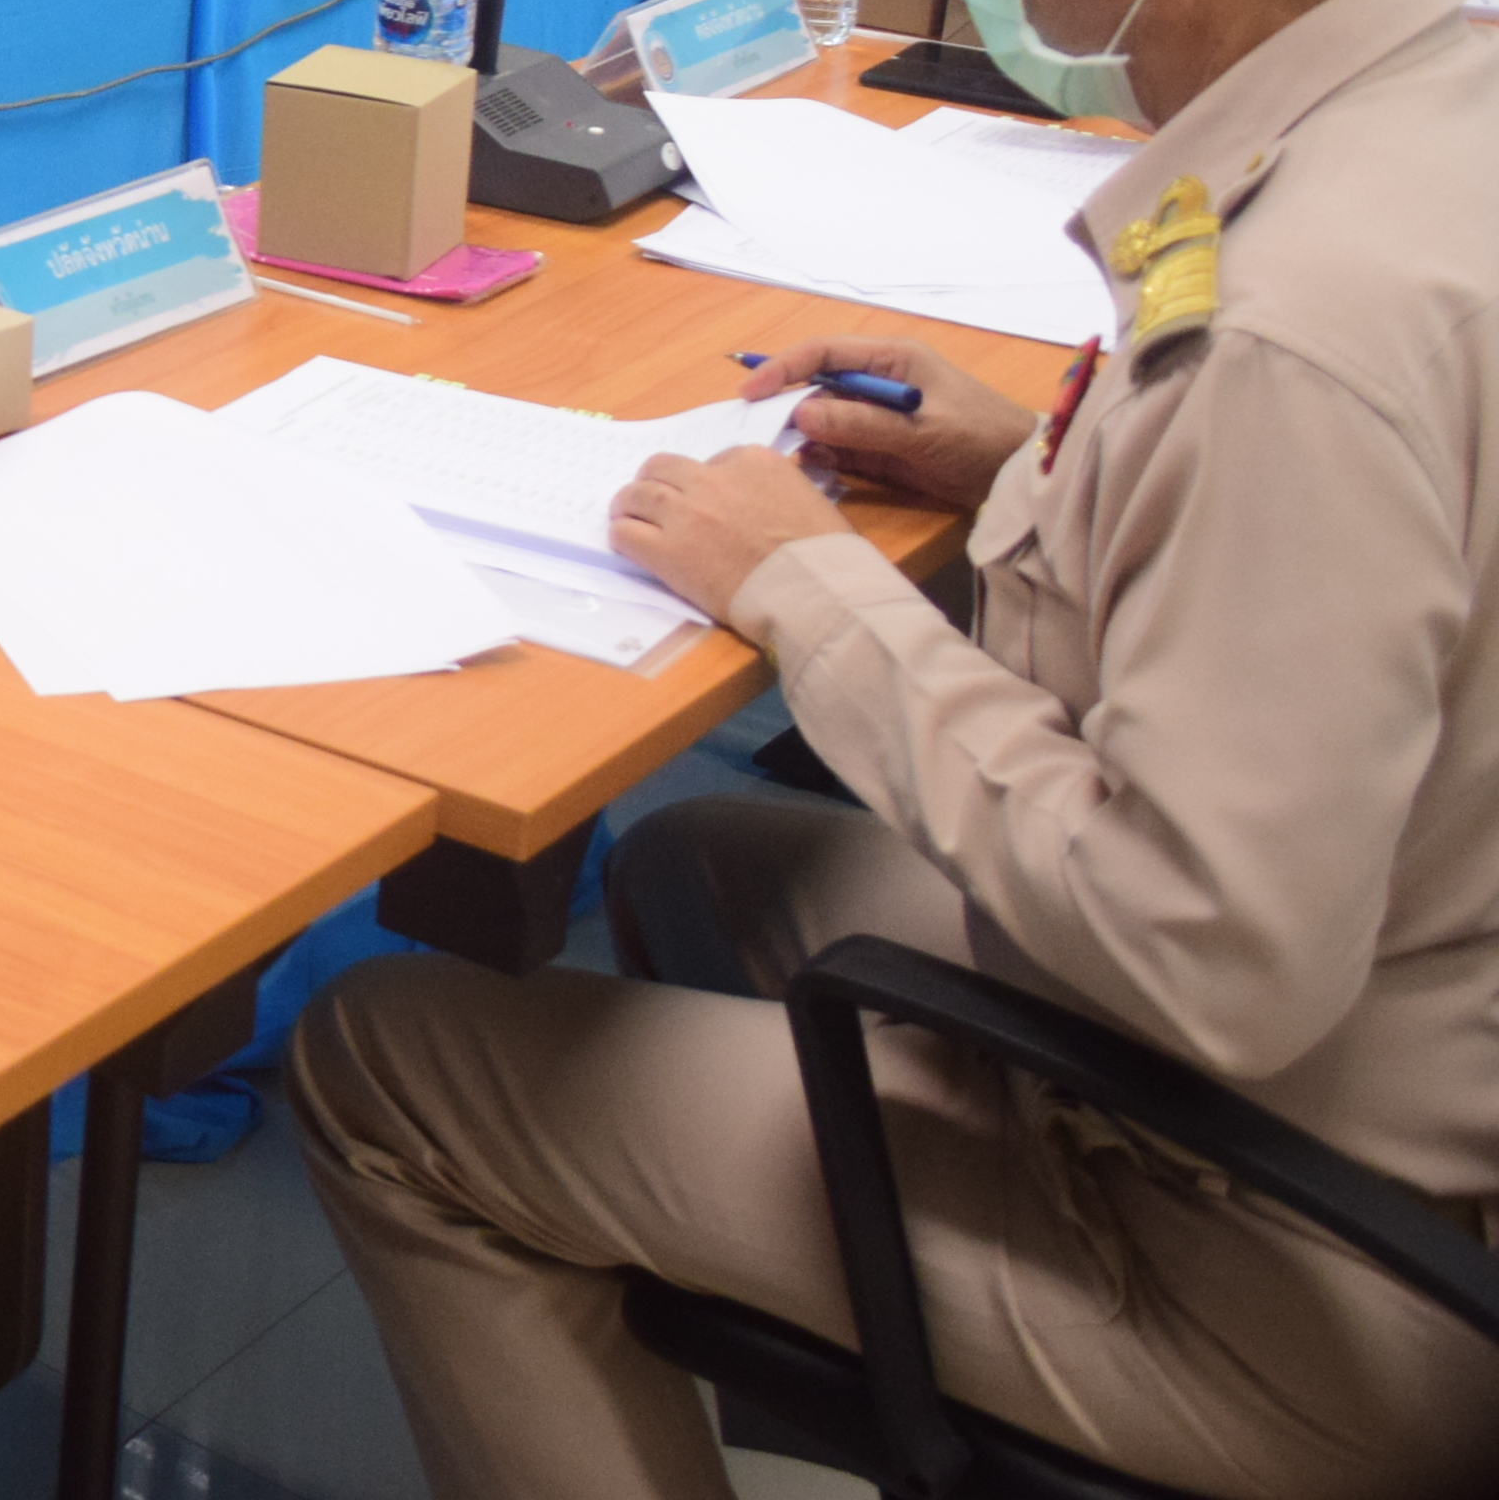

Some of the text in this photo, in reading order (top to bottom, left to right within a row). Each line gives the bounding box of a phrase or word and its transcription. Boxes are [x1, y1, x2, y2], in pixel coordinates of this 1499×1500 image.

[46, 219, 172, 280] ปลัดจังหวัดน่าน
